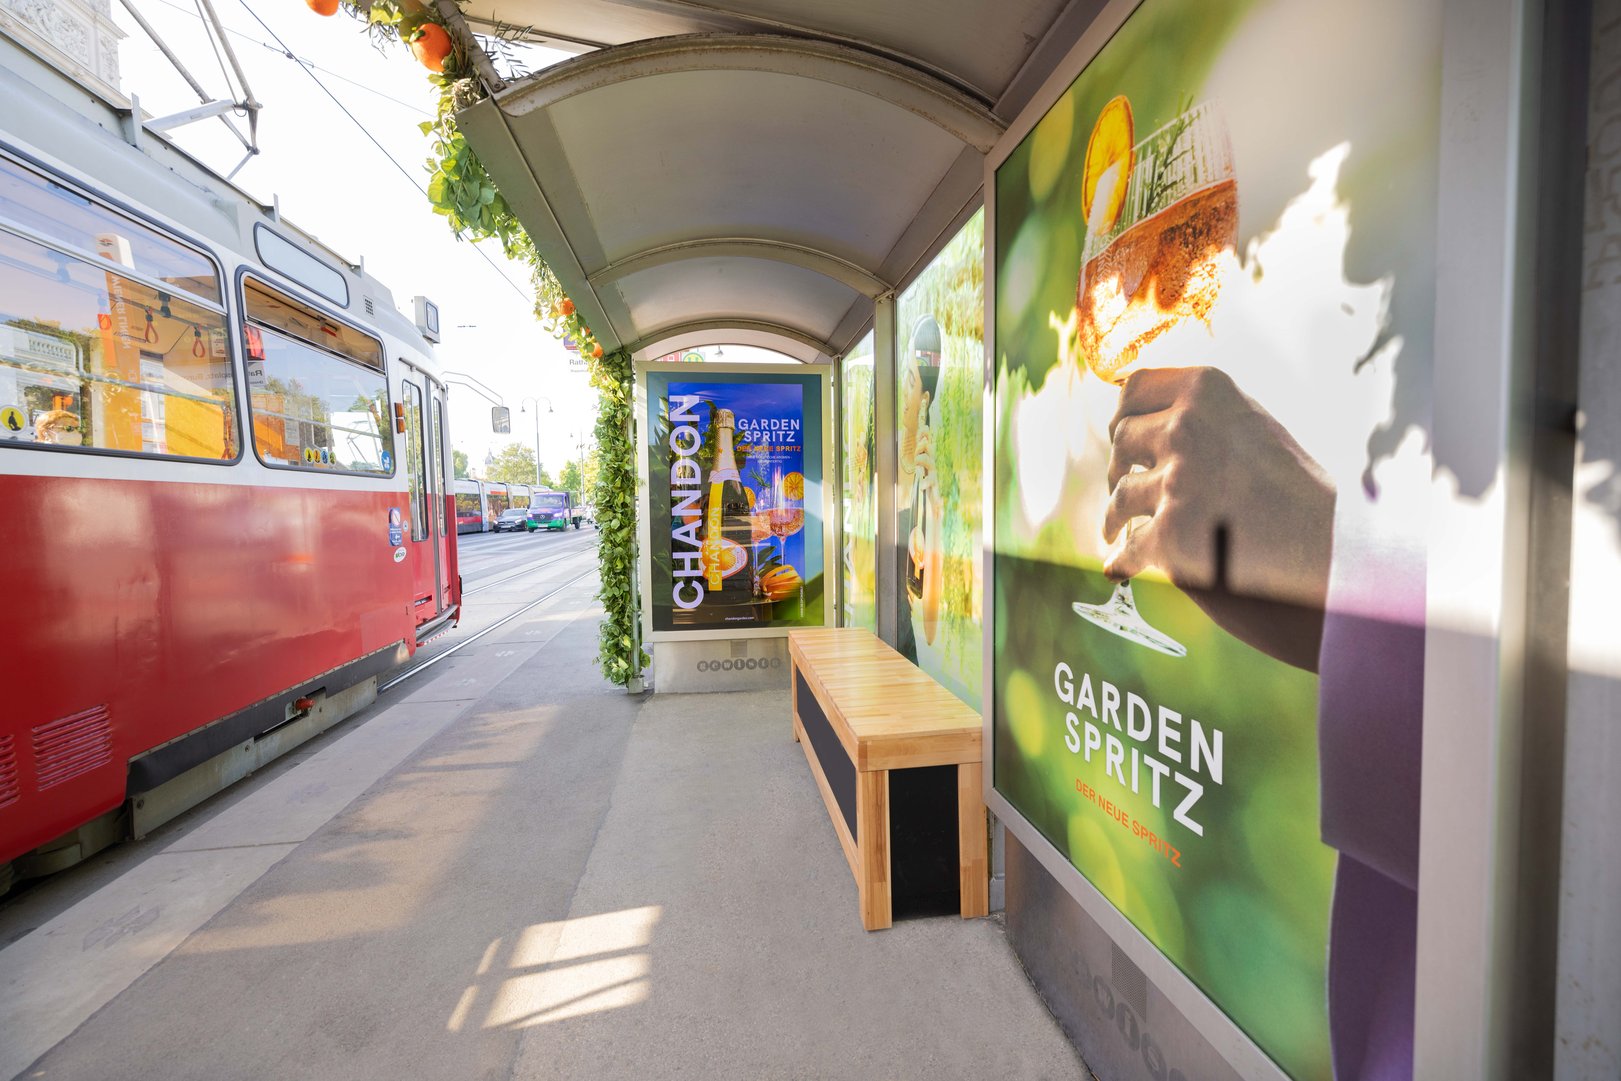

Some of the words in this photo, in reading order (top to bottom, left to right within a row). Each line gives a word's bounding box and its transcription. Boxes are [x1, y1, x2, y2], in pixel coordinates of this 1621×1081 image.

[738, 418, 800, 430] GARDEN
[743, 430, 796, 442] SPRITZ
[669, 394, 704, 610] CHANDON
[709, 506, 721, 585] CHANDON
[1054, 662, 1224, 785] GARDEN
[1064, 711, 1205, 837] SPRITZ
[1075, 778, 1096, 809] DER
[1098, 793, 1130, 830] NEUE
[1132, 820, 1182, 868] SPRITZ
